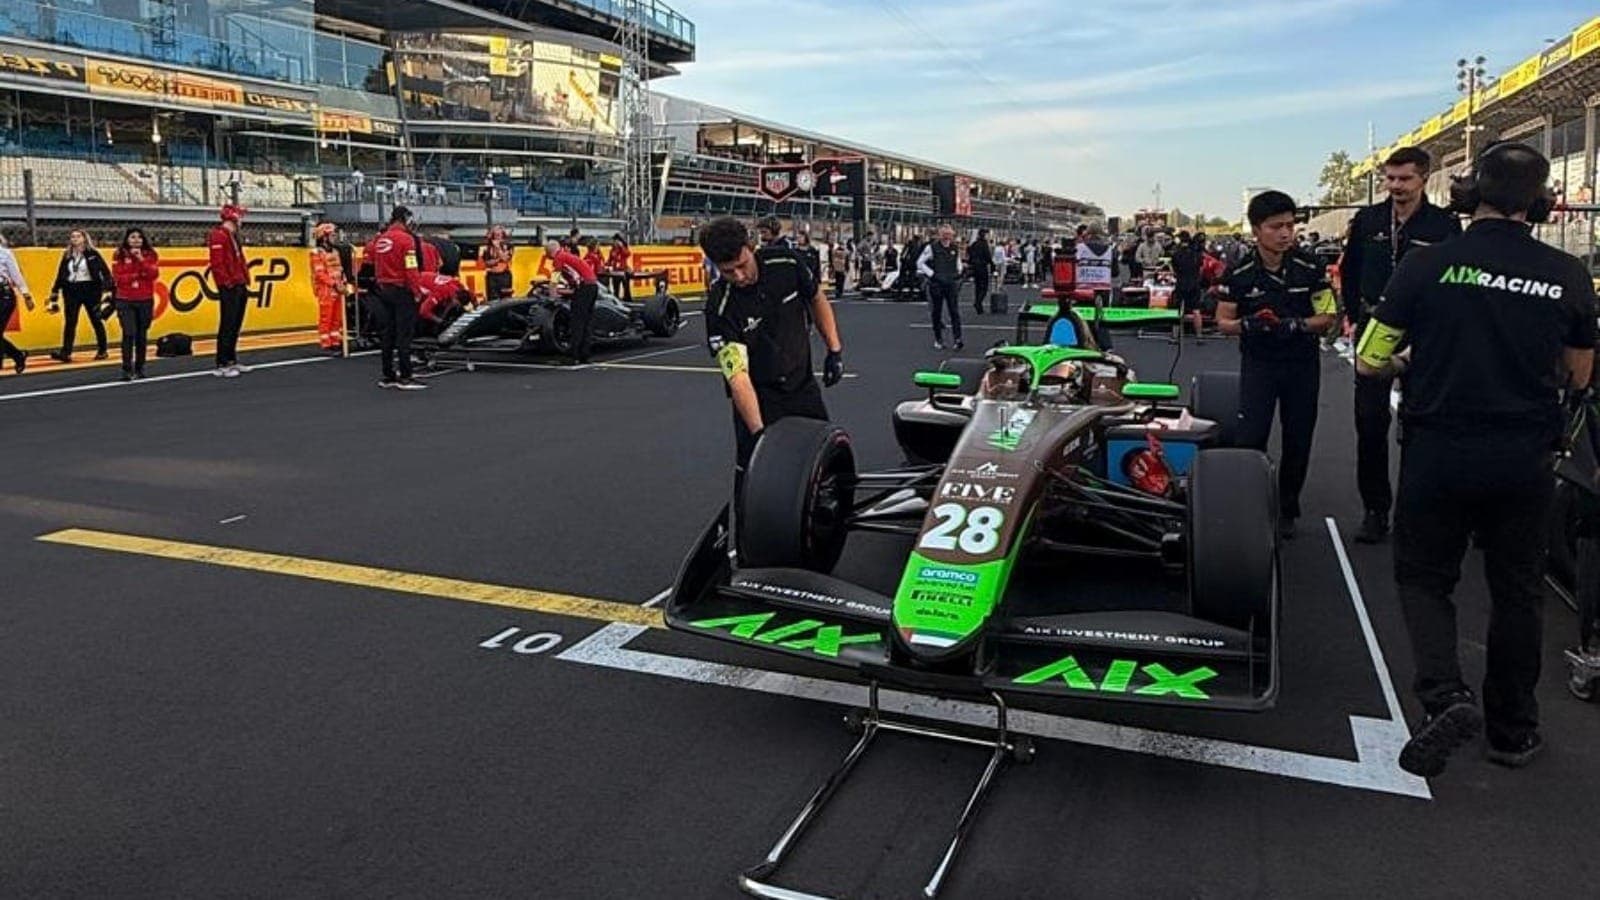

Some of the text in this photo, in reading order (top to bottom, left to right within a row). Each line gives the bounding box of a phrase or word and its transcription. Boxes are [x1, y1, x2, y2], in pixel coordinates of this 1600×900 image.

[941, 482, 1016, 503] FIVE
[919, 503, 1004, 554] 28
[921, 569, 976, 581] aramco
[740, 580, 759, 588] AIX
[762, 586, 845, 604] INVESTMENT
[688, 611, 881, 657] AIX
[1057, 629, 1160, 642] INVESTMENT
[1165, 635, 1225, 647] GROUP
[1011, 655, 1219, 699] AIX
